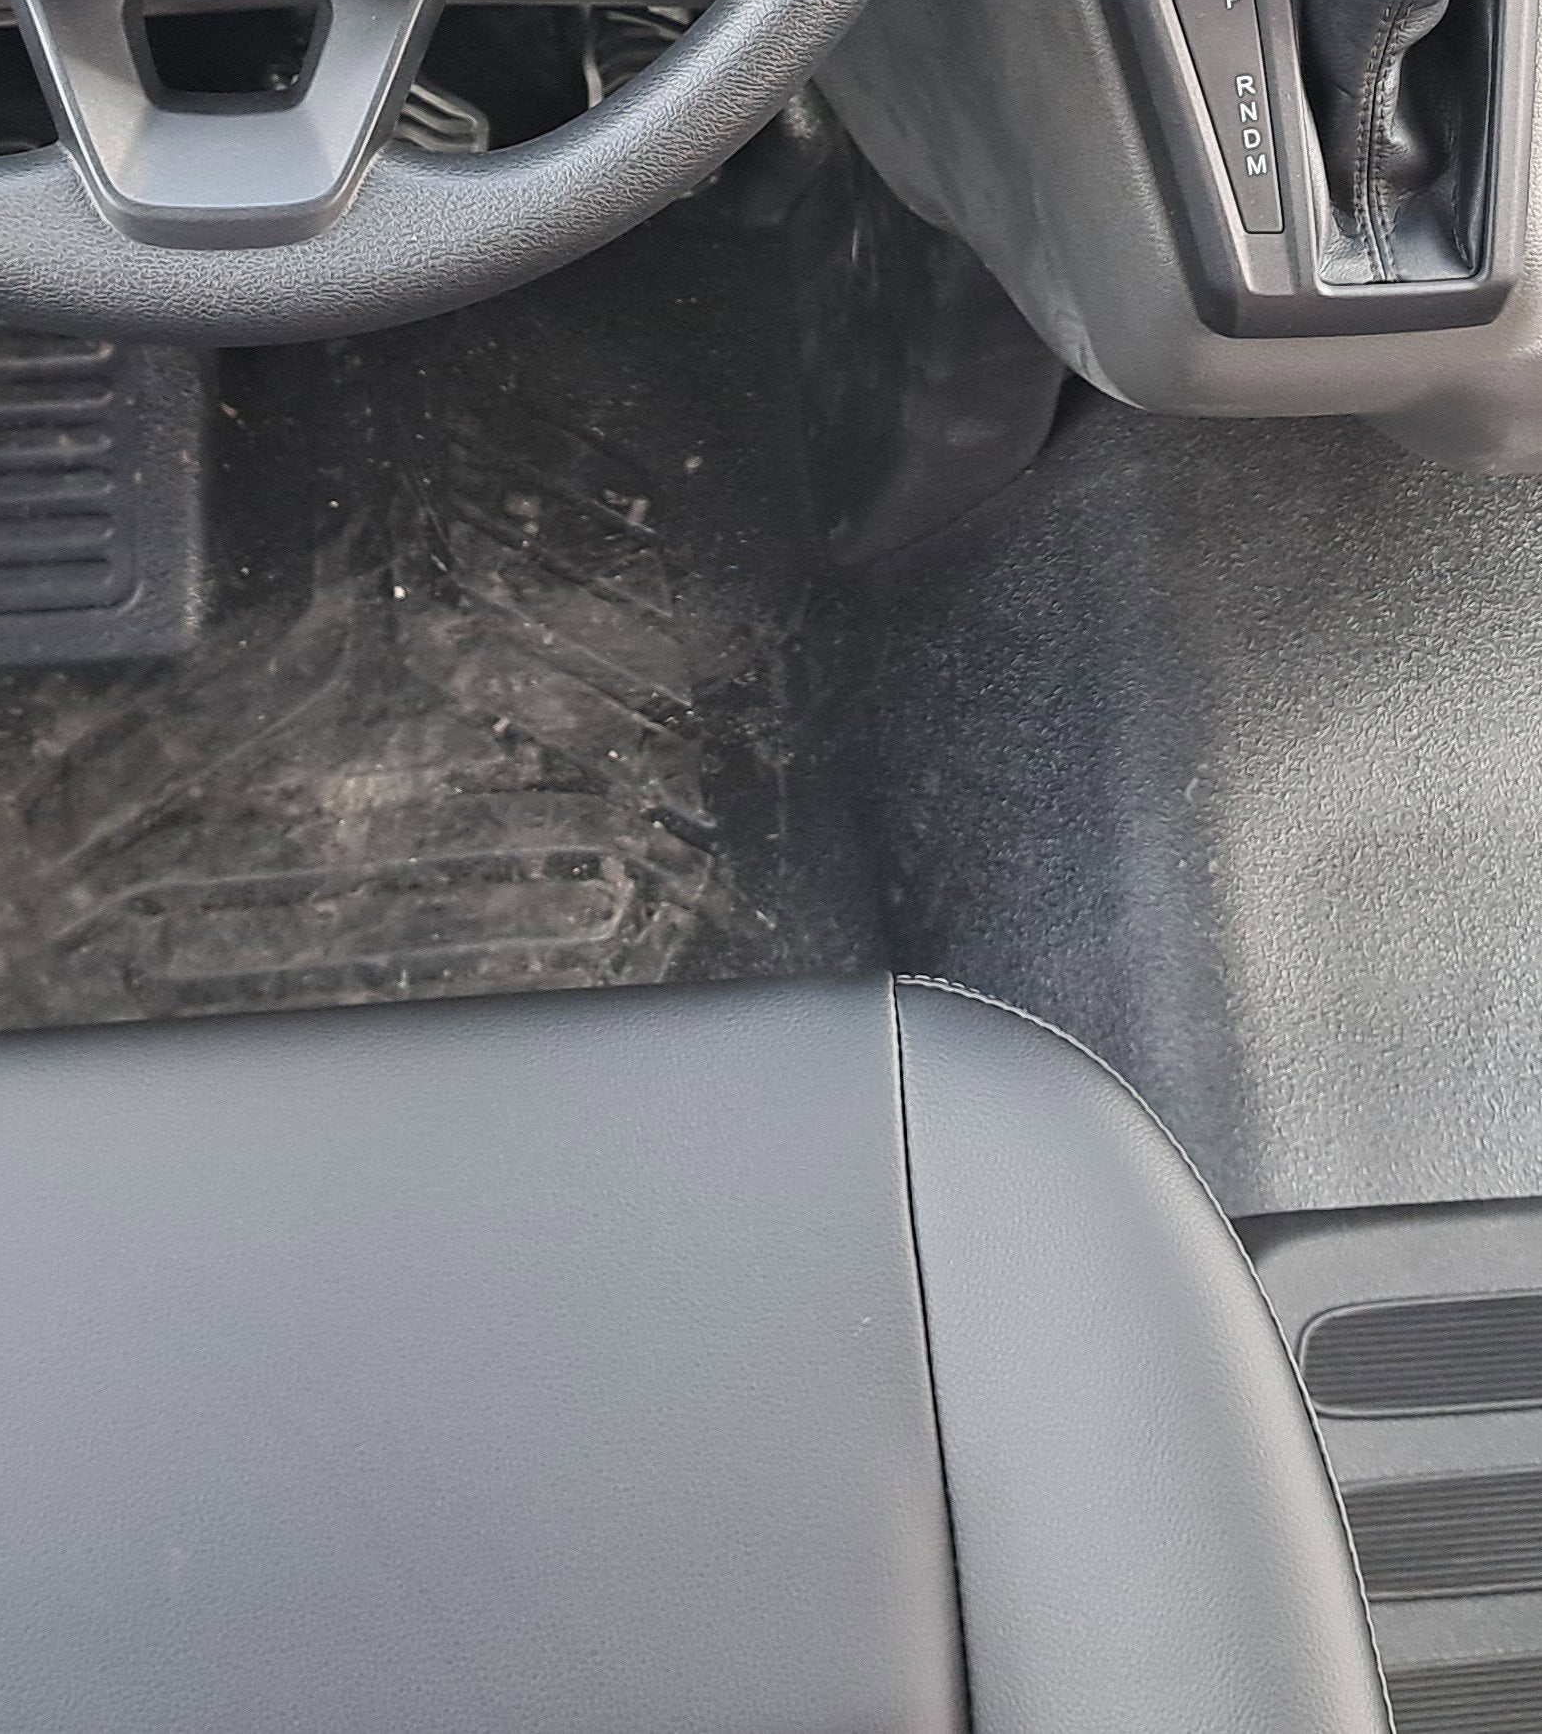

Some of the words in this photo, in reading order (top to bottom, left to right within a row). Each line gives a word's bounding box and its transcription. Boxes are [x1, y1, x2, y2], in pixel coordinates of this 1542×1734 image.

[1236, 75, 1257, 96] R
[1239, 103, 1258, 122] N
[1243, 128, 1262, 148] D
[1247, 155, 1268, 176] M
